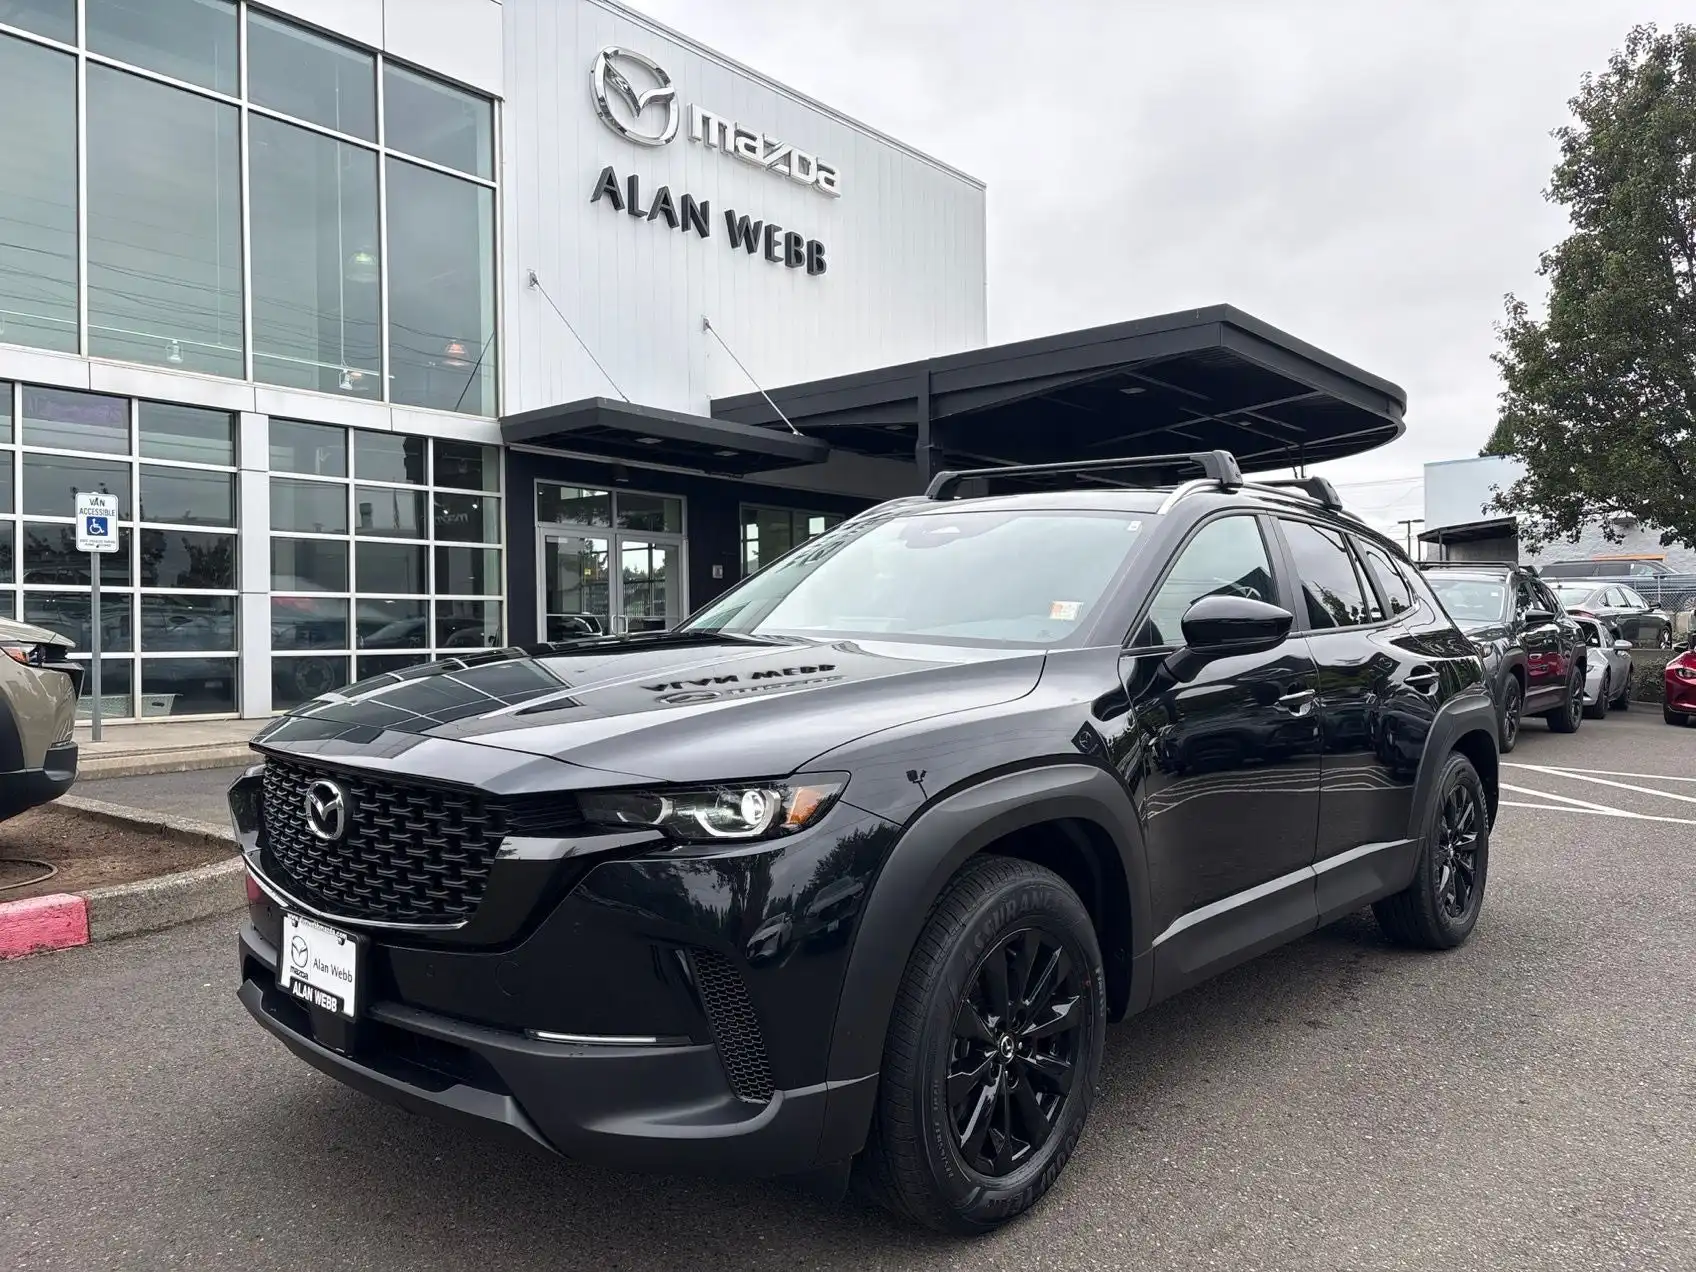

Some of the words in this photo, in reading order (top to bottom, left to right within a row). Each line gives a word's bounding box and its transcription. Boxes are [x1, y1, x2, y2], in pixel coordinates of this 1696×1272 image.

[590, 165, 710, 238] ALAN
[724, 209, 827, 276] WEBB
[79, 508, 115, 516] ACCESSIBLE
[89, 498, 106, 507] VAN
[313, 958, 329, 974] Alan
[331, 964, 353, 983] Webb
[292, 981, 314, 1002] ALAN
[314, 989, 337, 1013] WEBB
